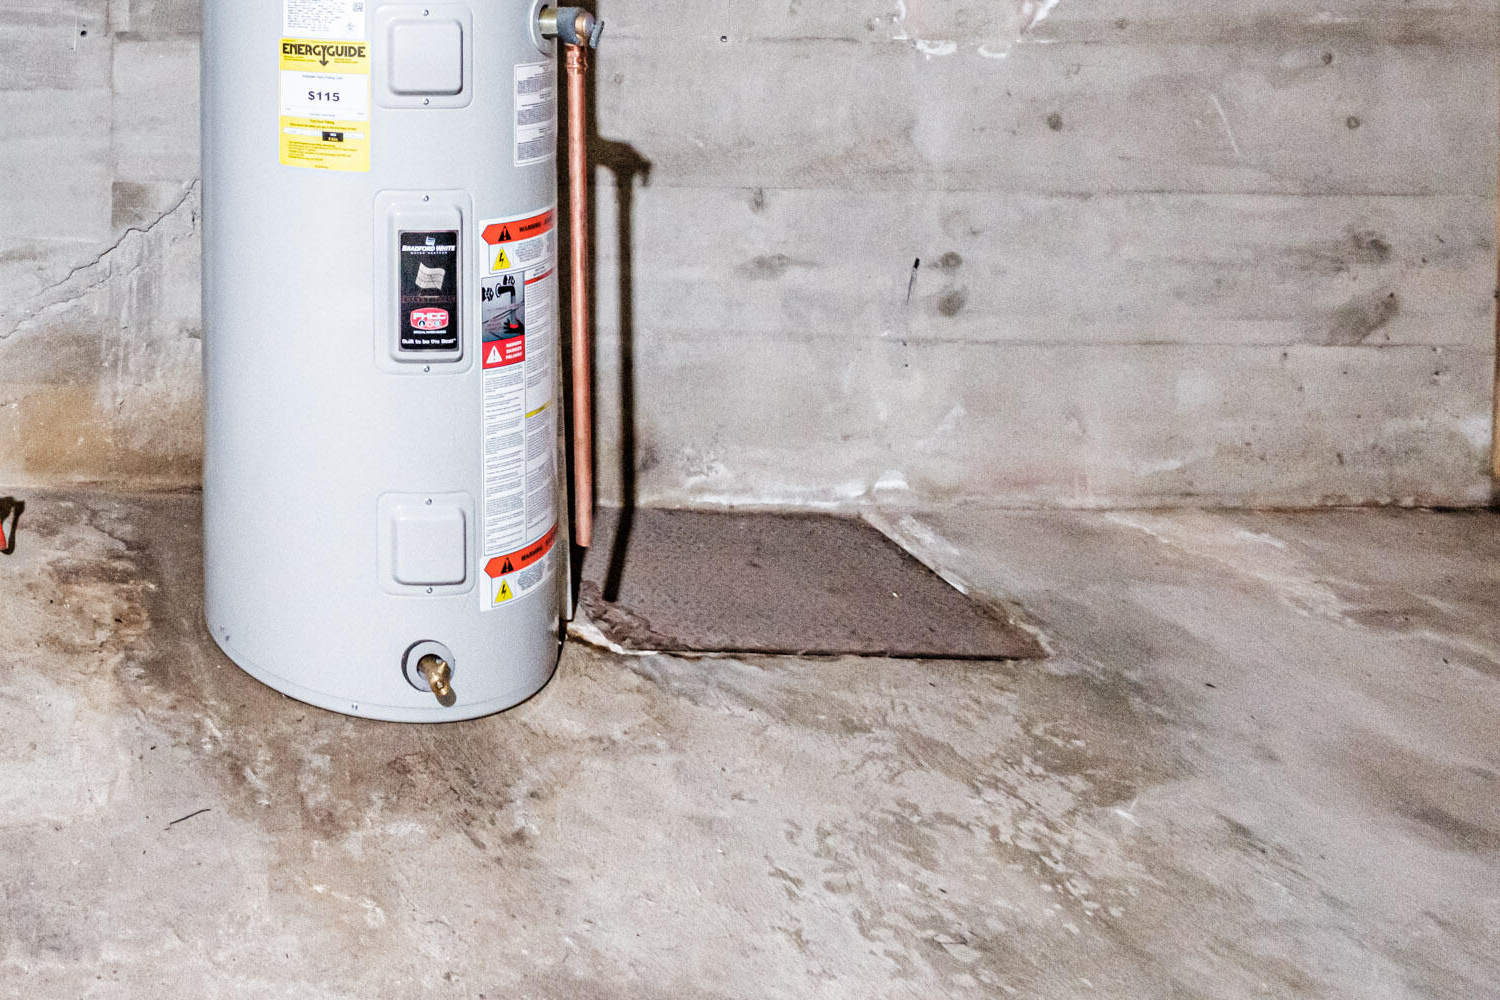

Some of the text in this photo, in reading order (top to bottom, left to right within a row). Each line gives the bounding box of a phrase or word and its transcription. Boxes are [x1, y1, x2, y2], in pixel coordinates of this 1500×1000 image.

[282, 42, 366, 59] ENERGYGUIDE
[308, 90, 340, 102] $115
[413, 312, 447, 320] PHCC
